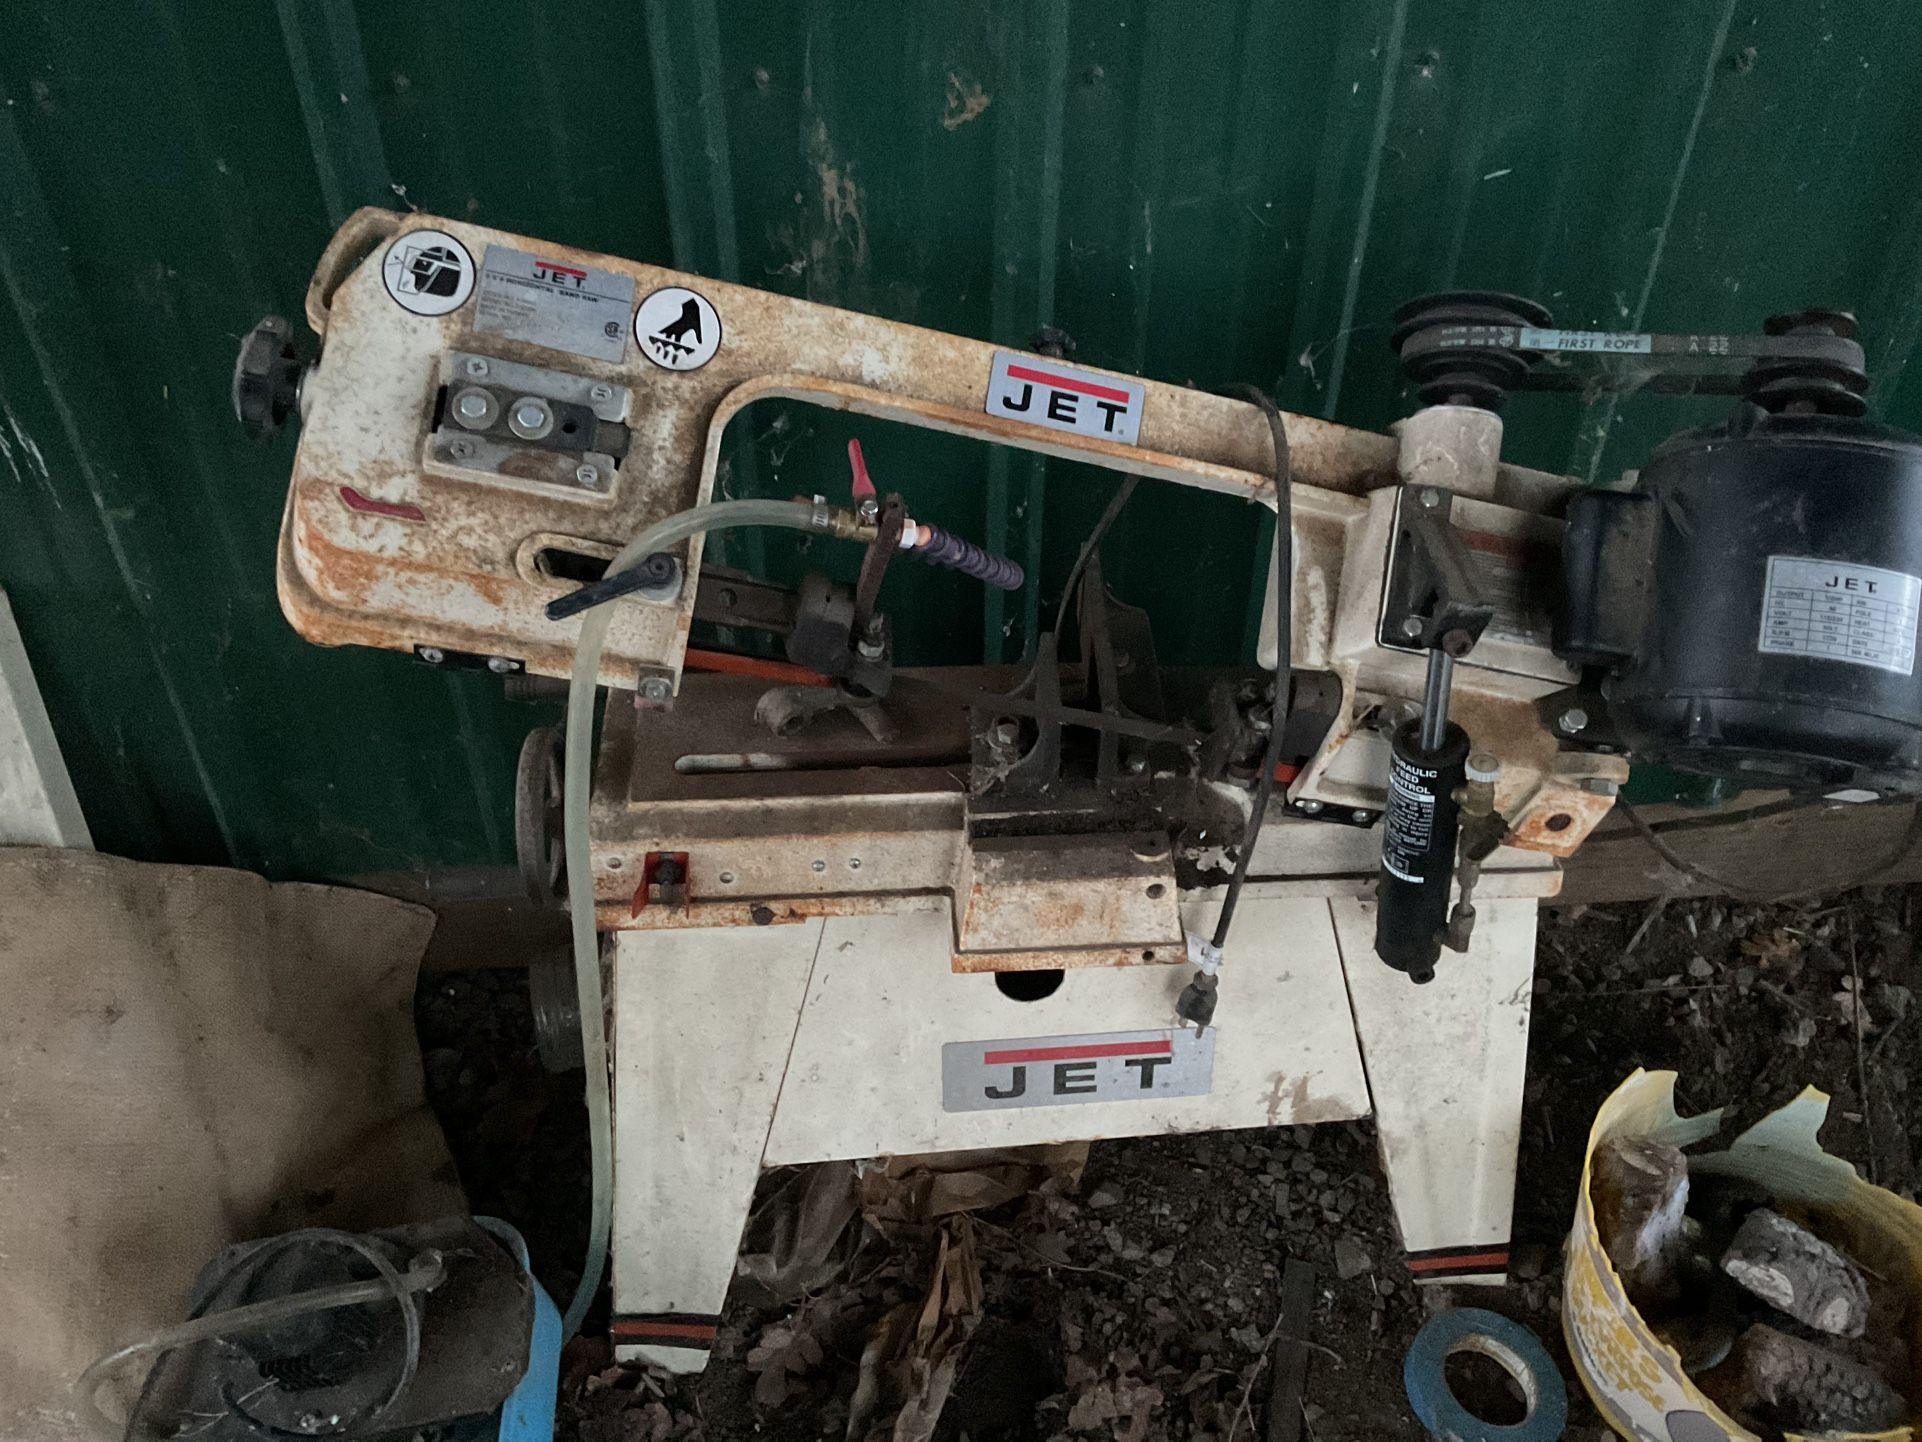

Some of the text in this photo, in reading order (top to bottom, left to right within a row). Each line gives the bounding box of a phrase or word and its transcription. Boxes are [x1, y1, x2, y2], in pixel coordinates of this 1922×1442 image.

[532, 269, 587, 288] JET
[1558, 338, 1641, 350] FIRST ROPE
[1002, 384, 1128, 433] JET
[1825, 575, 1879, 594] JET
[1396, 766, 1419, 784] FEED
[984, 1056, 1172, 1099] JET
